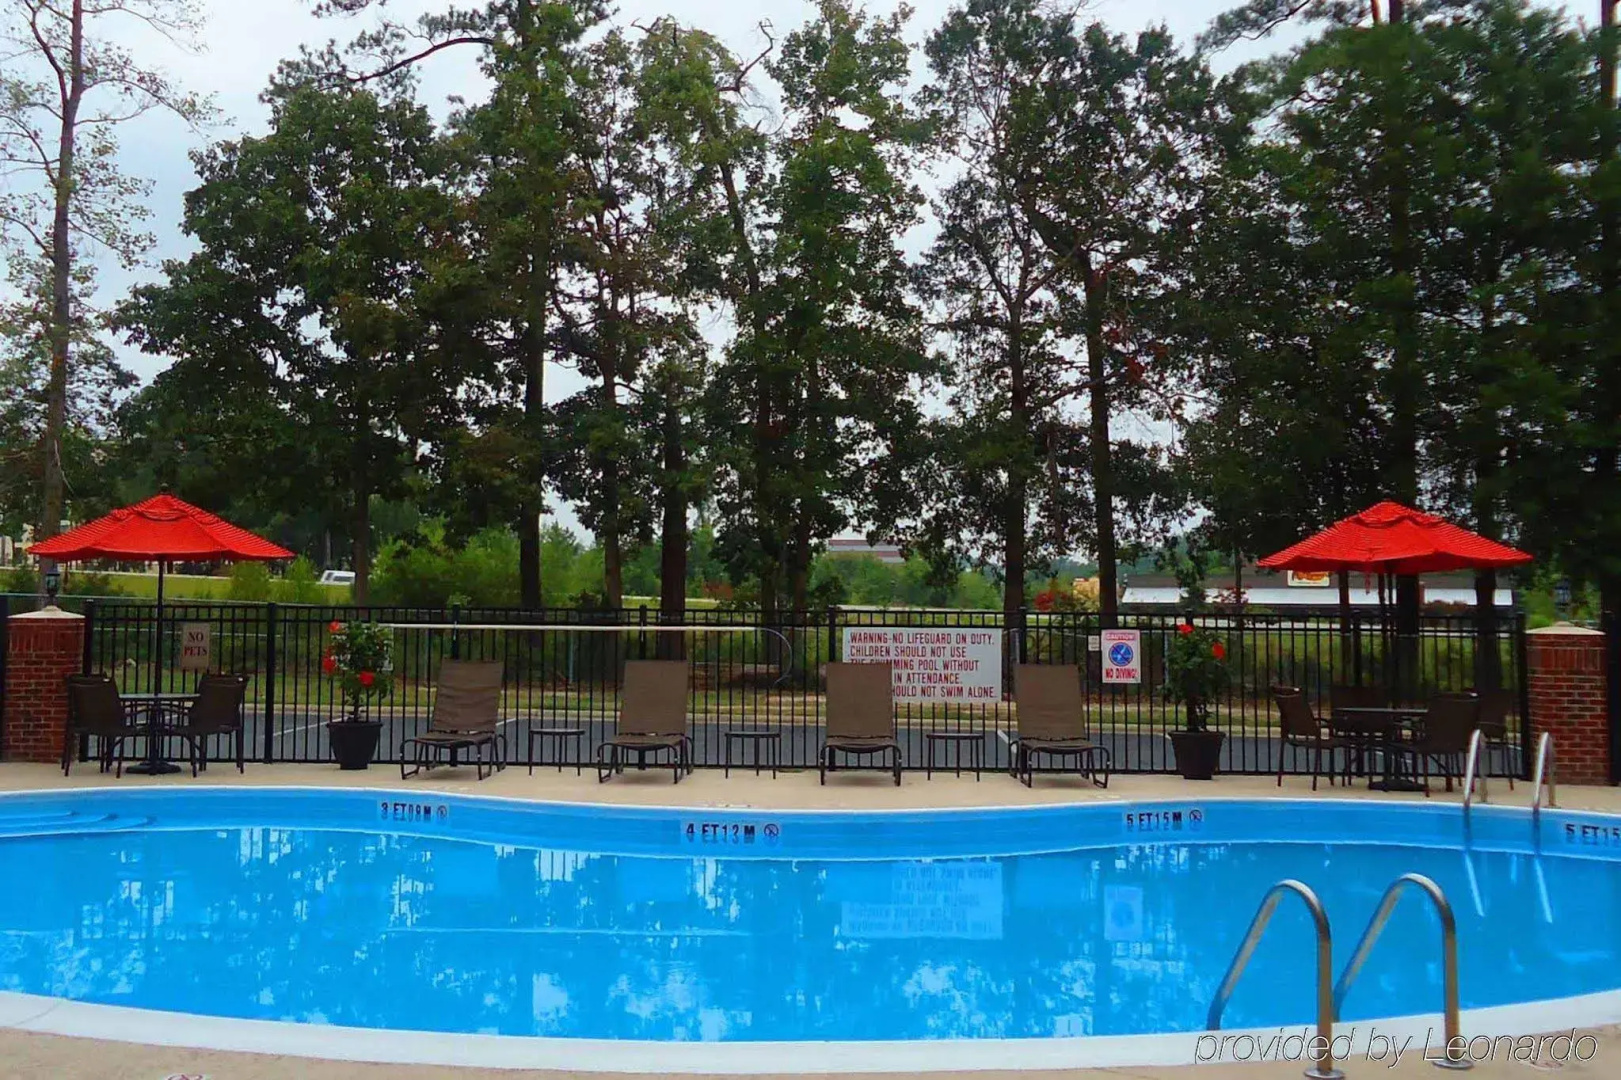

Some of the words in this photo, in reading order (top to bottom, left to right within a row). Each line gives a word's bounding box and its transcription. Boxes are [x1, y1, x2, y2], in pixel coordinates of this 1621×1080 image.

[189, 632, 204, 641] NO
[907, 633, 951, 645] LIFEGUARD
[956, 634, 967, 645] ON
[970, 634, 995, 645] DUTY.
[184, 646, 207, 656] PETS
[850, 646, 890, 657] CHILDREN
[895, 646, 927, 658] SHOULD
[930, 647, 947, 658] NOT
[951, 647, 966, 658] USE
[918, 660, 939, 671] POOL
[943, 660, 979, 671] WITHOUT
[894, 673, 902, 683] IN
[906, 673, 962, 684] ATTENDANCE.
[1106, 668, 1113, 678] NO
[921, 686, 936, 697] NOT
[941, 686, 963, 698] SWIM
[968, 686, 997, 698] ALONE.
